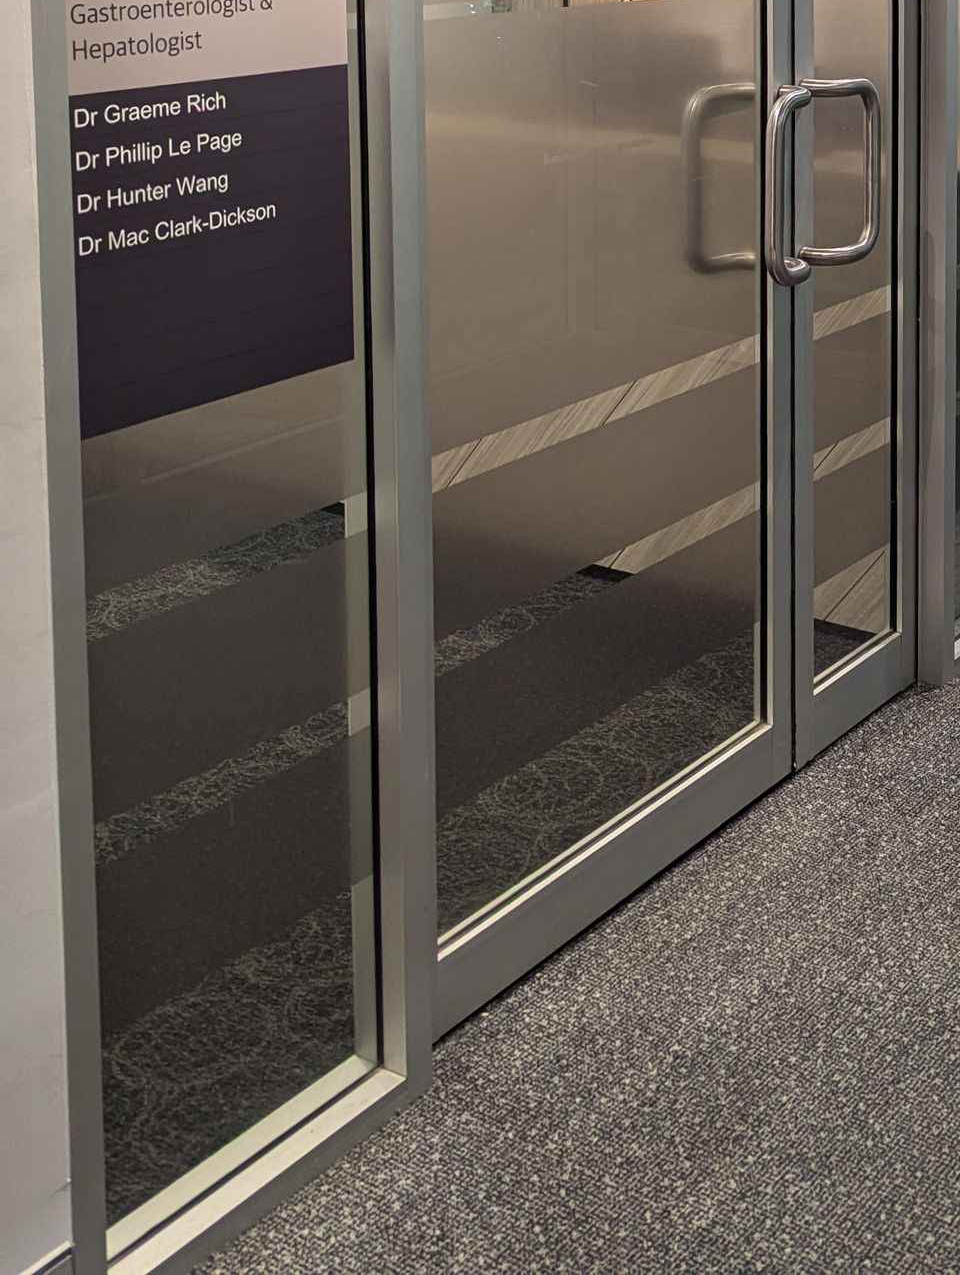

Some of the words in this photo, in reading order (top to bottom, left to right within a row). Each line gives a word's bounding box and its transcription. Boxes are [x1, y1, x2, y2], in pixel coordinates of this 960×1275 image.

[72, 30, 202, 63] Hepatologist
[74, 107, 98, 128] Dr
[104, 99, 181, 124] Graeme
[187, 91, 226, 114] Rich
[75, 150, 99, 171] Dr
[105, 142, 162, 167] Phillip
[168, 137, 191, 157] Le
[197, 130, 242, 153] Page
[77, 193, 101, 214] Dr
[107, 183, 171, 209] Hunter
[176, 173, 229, 196] Wang
[79, 235, 102, 256] Dr
[108, 226, 149, 251] Mac
[154, 204, 276, 241] Clark-Dickson
